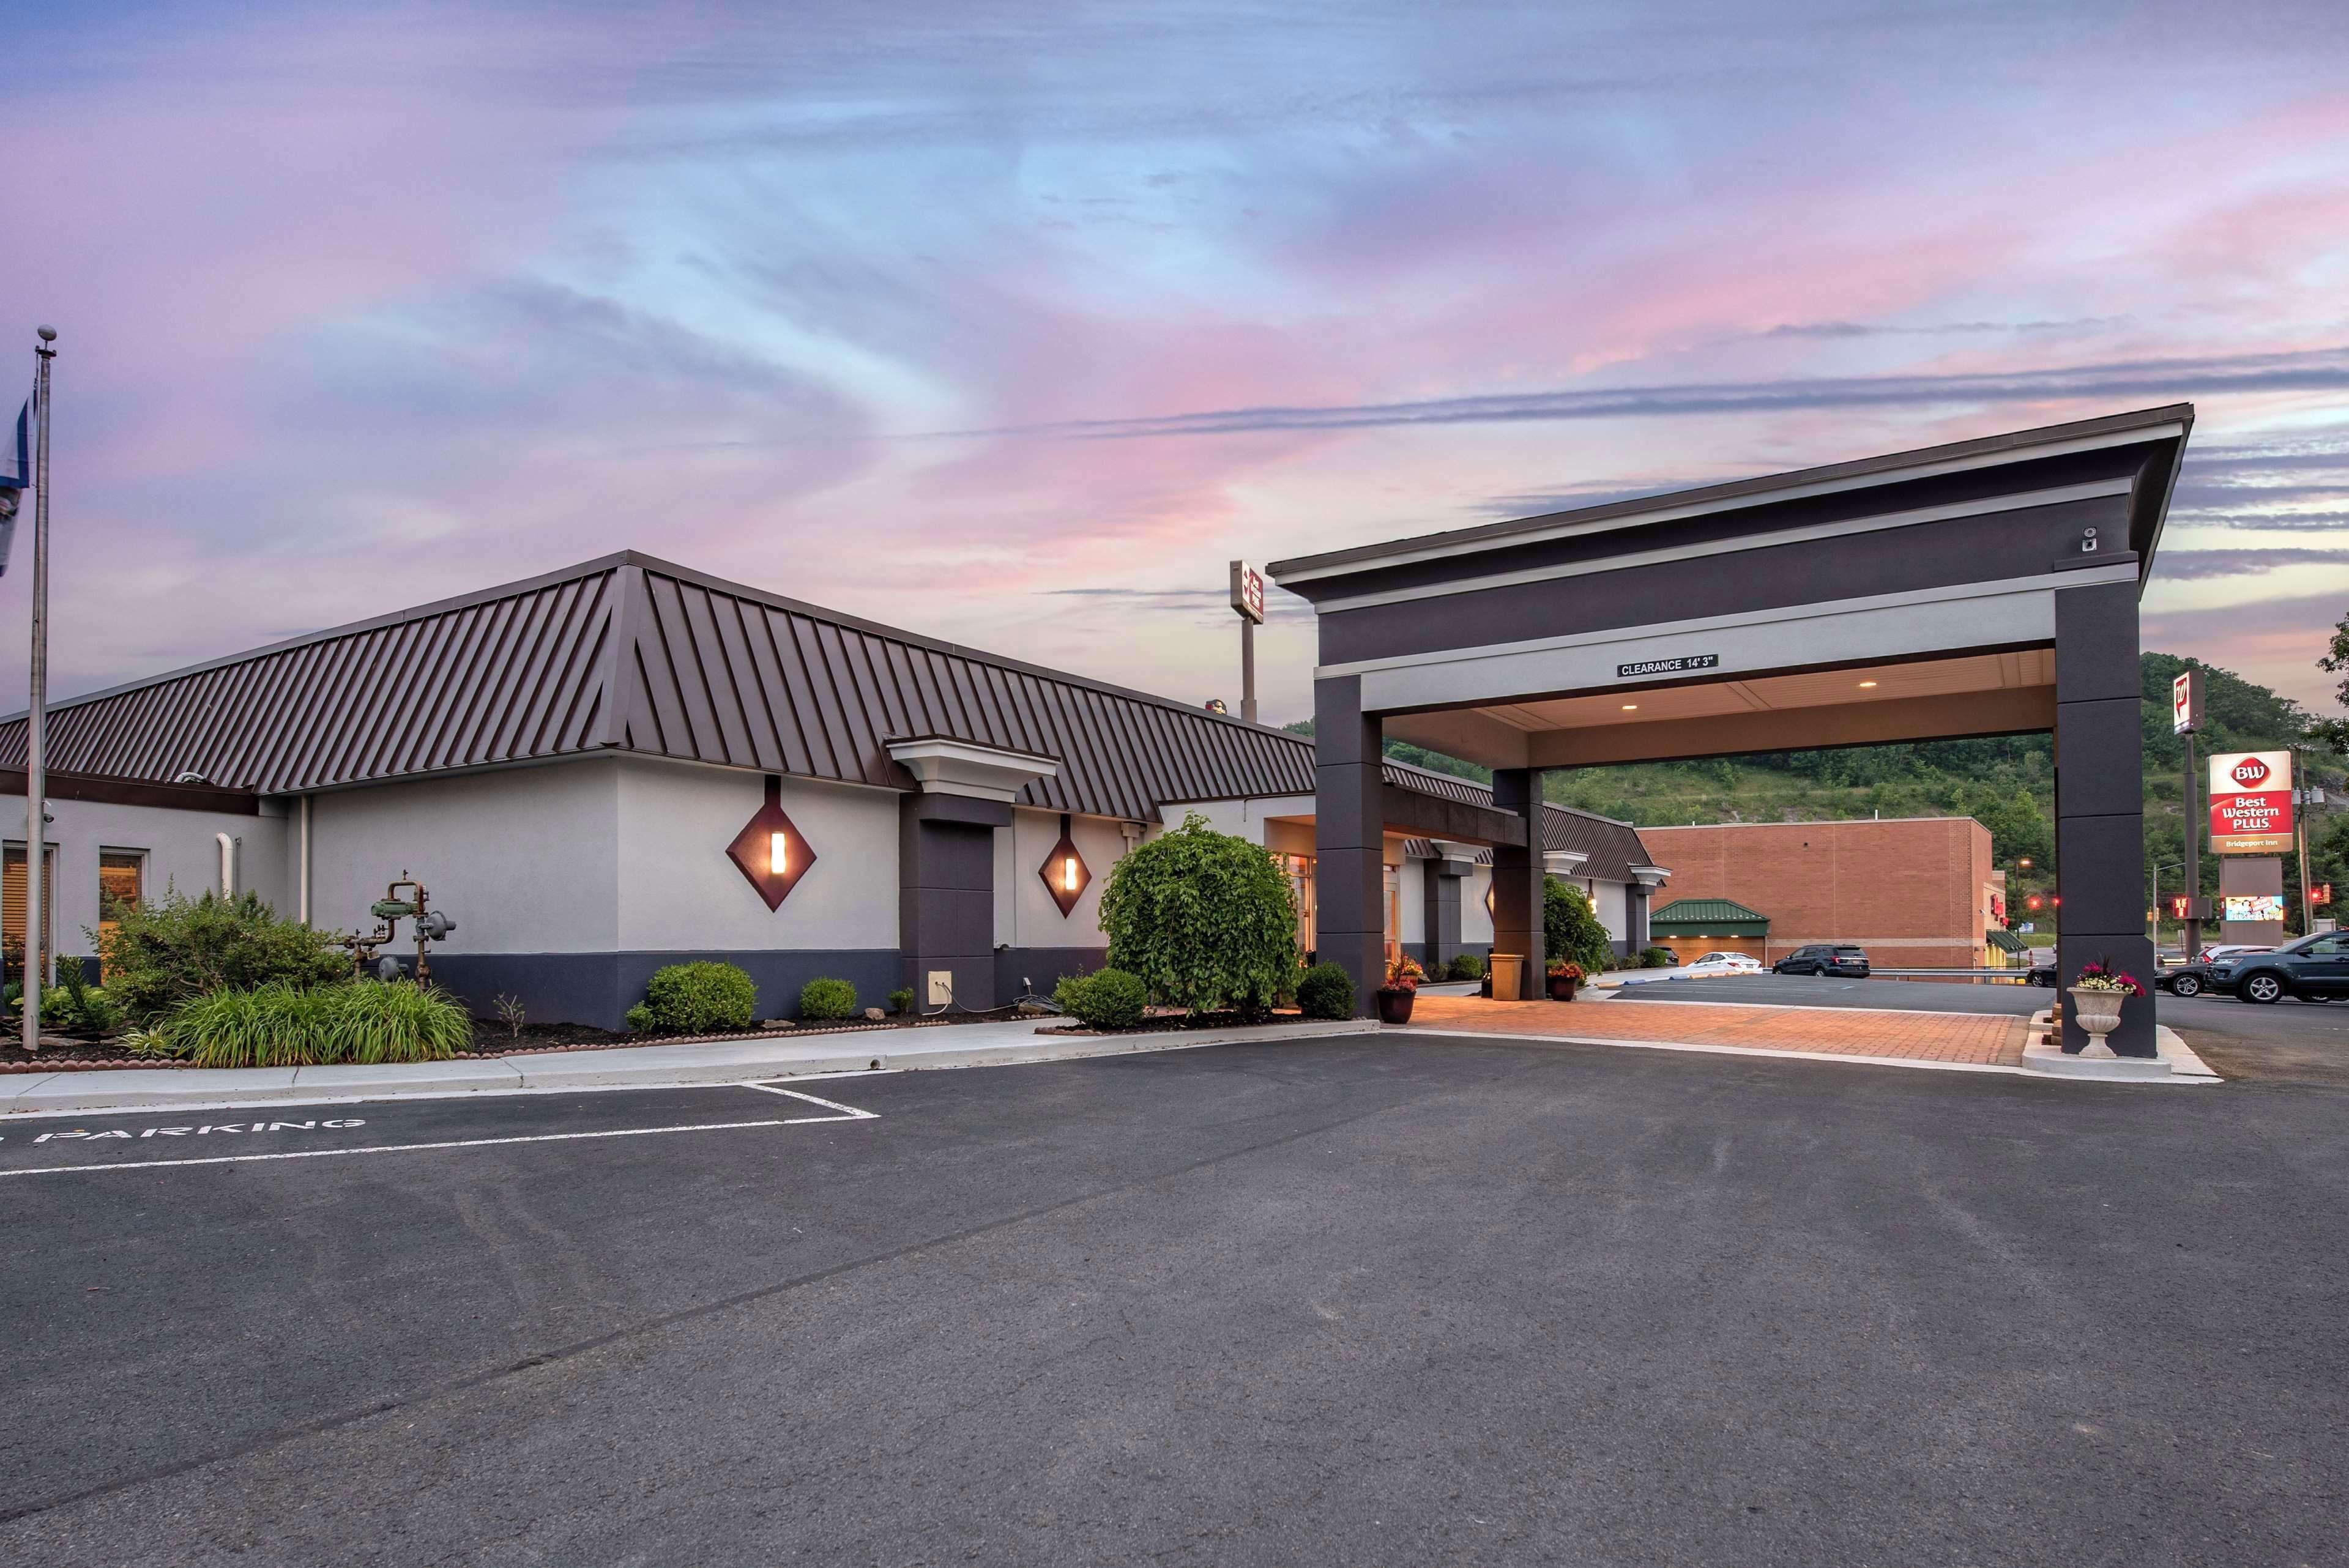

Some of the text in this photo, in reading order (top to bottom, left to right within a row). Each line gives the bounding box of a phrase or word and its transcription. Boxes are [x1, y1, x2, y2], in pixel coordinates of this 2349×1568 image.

[1621, 660, 1681, 675] CLEARANCE
[2235, 766, 2265, 780] BW
[2235, 797, 2266, 808] Best
[2222, 808, 2280, 818] Western
[33, 1119, 367, 1143] PARKING
